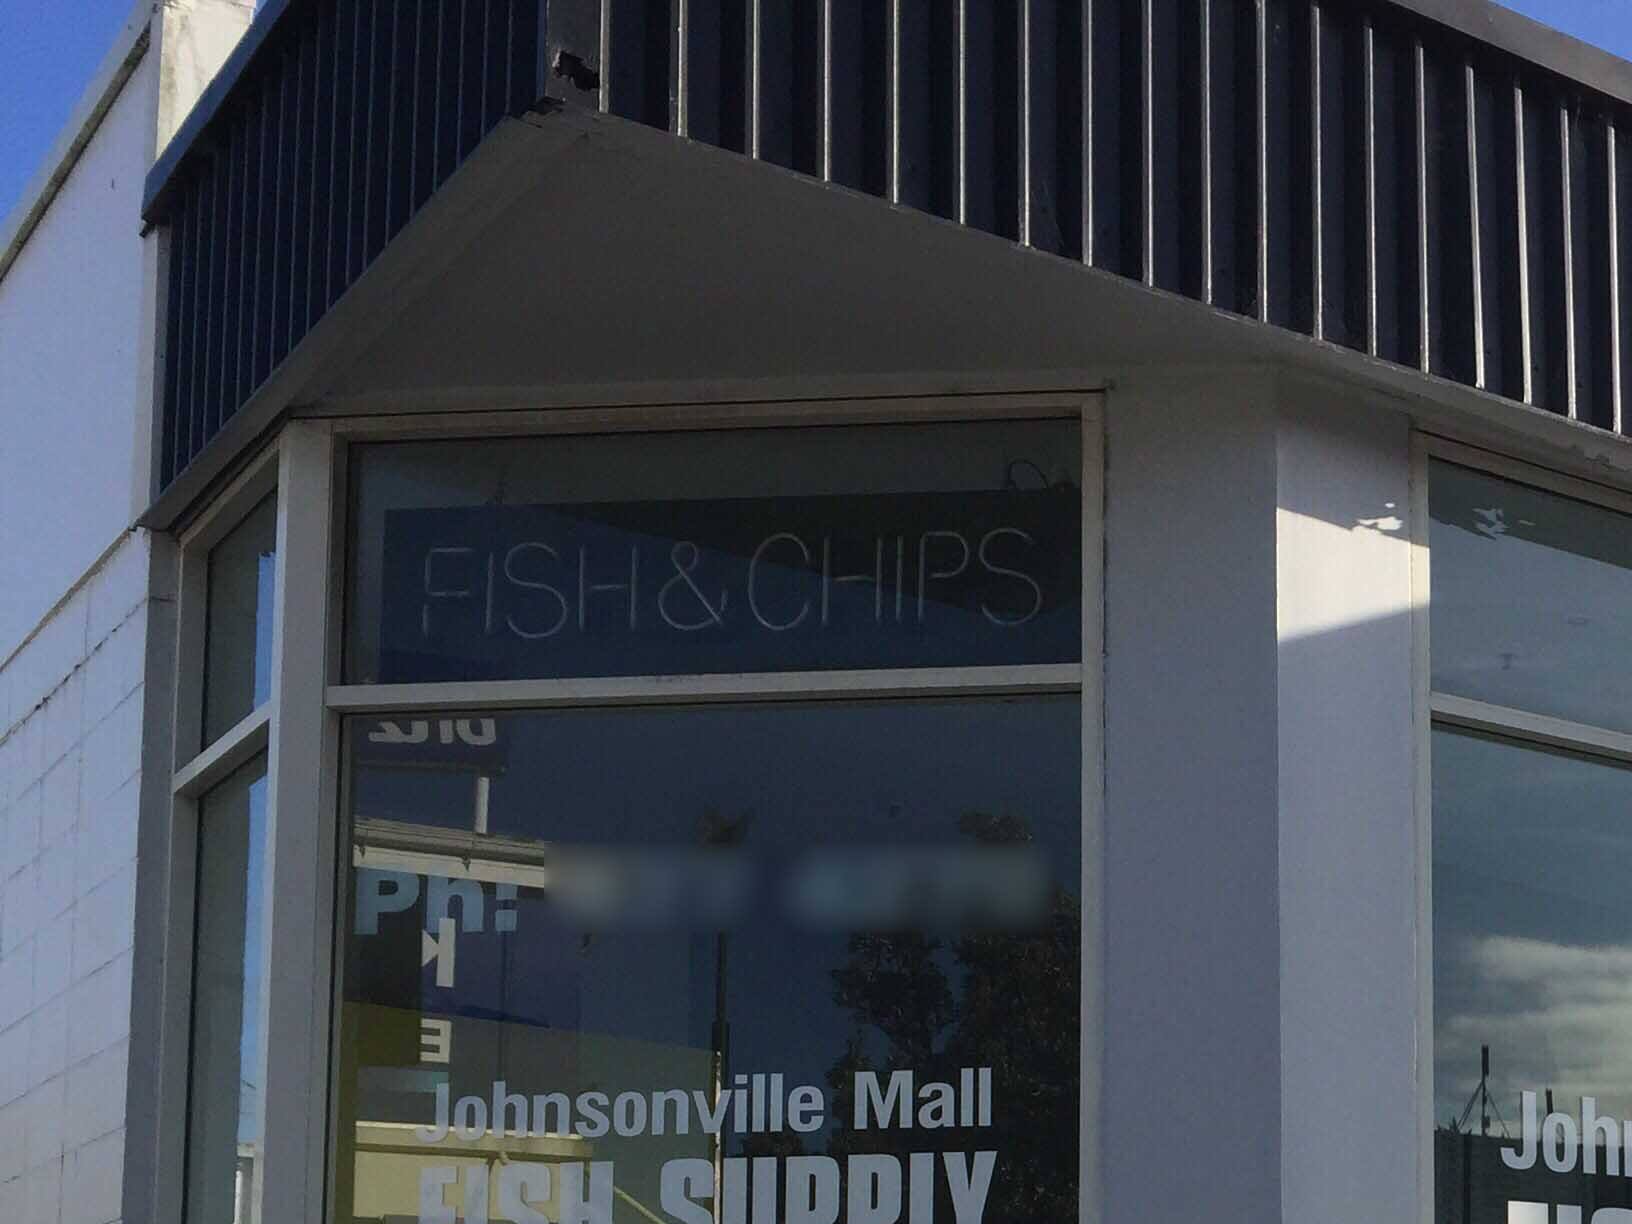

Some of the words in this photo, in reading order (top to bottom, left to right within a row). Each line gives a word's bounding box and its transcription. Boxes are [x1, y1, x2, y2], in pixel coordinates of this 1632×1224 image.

[747, 527, 1043, 632] CHIPS
[354, 868, 519, 935] Ph:
[416, 1071, 826, 1143] Johnsonville
[855, 1067, 993, 1131] Mall
